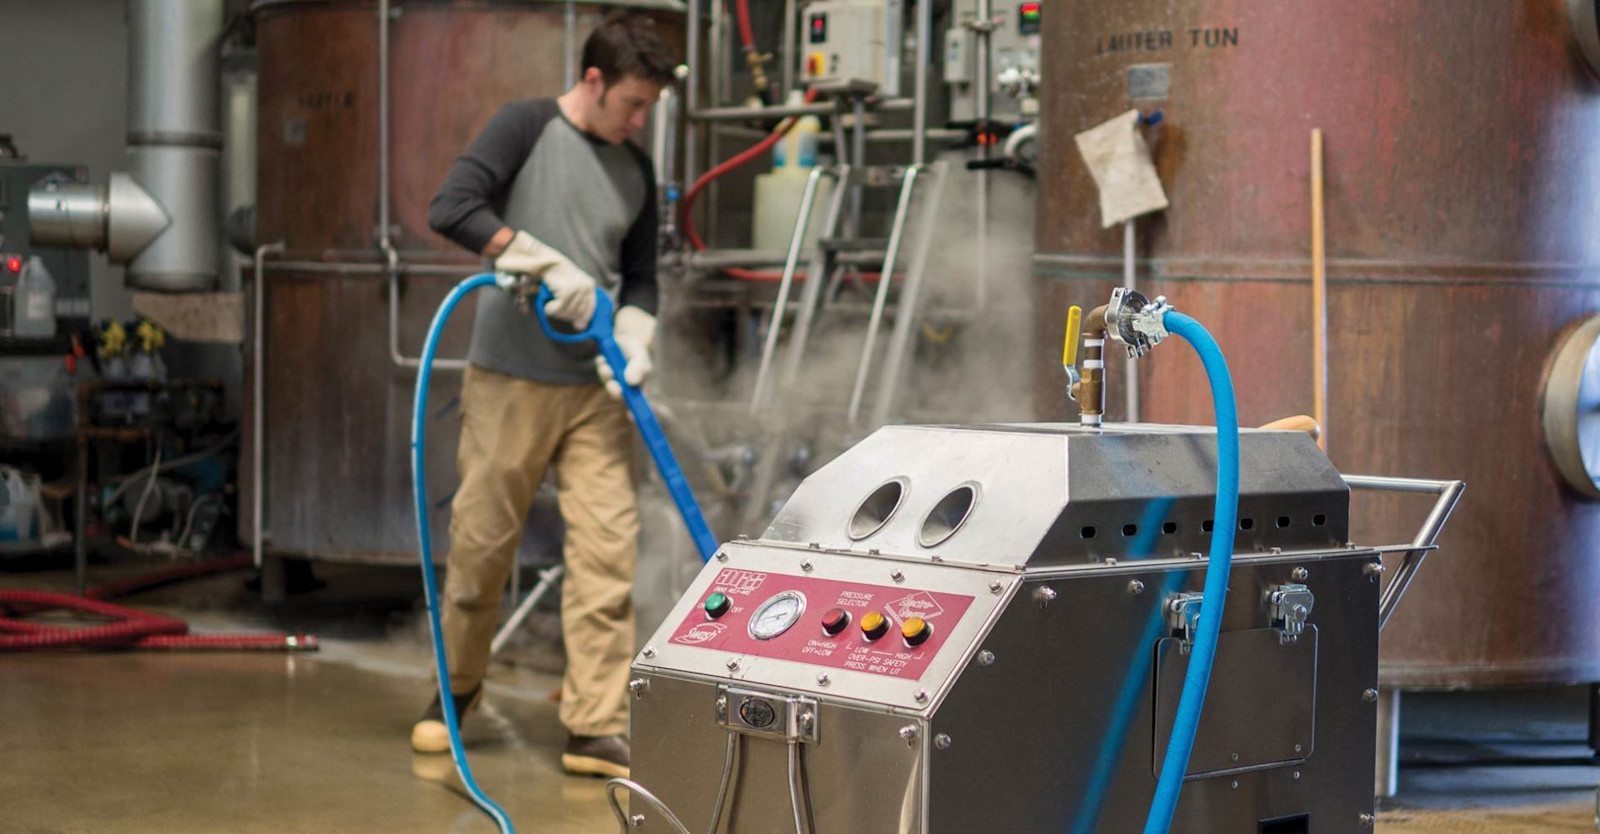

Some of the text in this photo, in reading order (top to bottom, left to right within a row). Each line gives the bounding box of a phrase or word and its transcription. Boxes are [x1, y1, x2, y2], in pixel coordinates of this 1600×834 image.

[1190, 27, 1238, 48] TUN
[840, 590, 875, 601] PRESSURE
[836, 599, 869, 608] SELECTOR
[807, 639, 838, 649] ON=HIGH
[802, 646, 833, 657] OFF=LOW
[854, 646, 912, 661] LOW HIGH
[848, 653, 908, 668] OVER-PSI SAFETY
[844, 661, 866, 670] PRESS
[869, 664, 888, 673] WHEN
